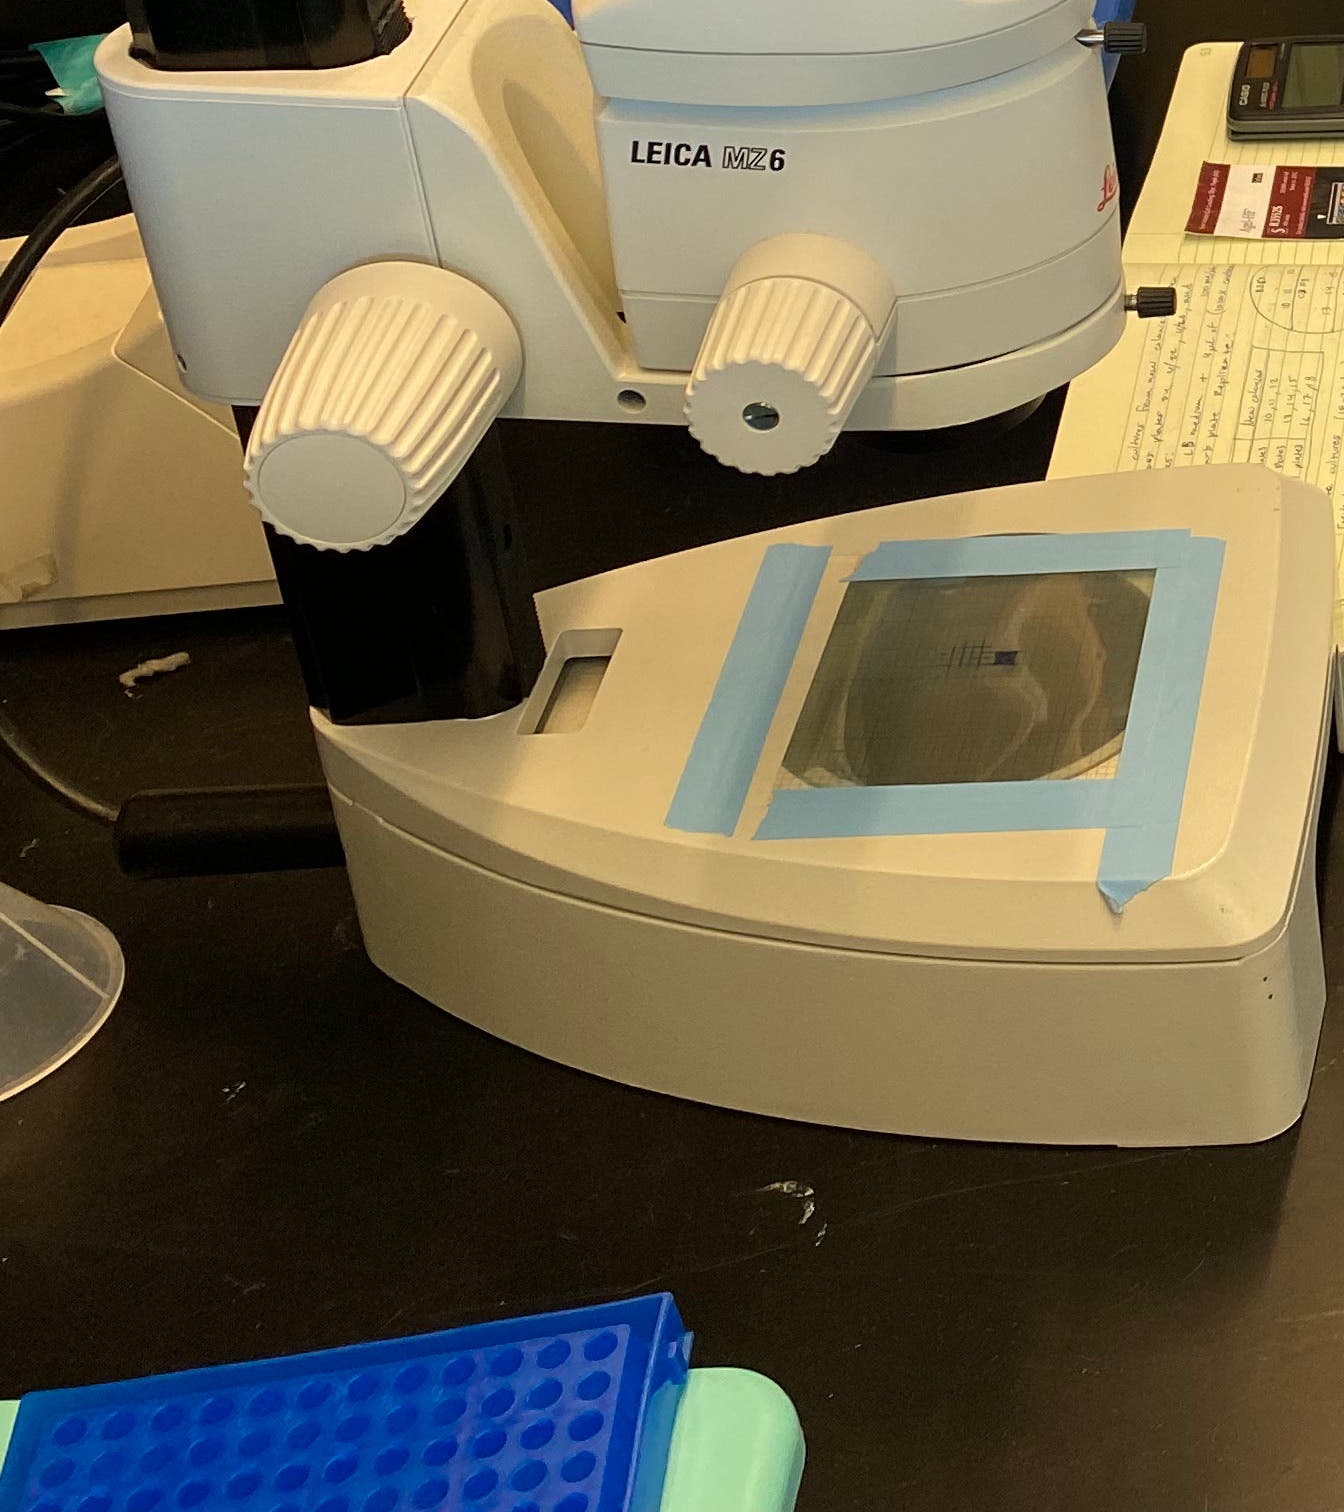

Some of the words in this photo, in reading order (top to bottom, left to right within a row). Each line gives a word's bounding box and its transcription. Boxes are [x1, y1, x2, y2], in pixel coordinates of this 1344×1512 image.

[1239, 84, 1250, 106] CASIO
[631, 141, 712, 167] LEICA
[722, 146, 786, 171] MZ6
